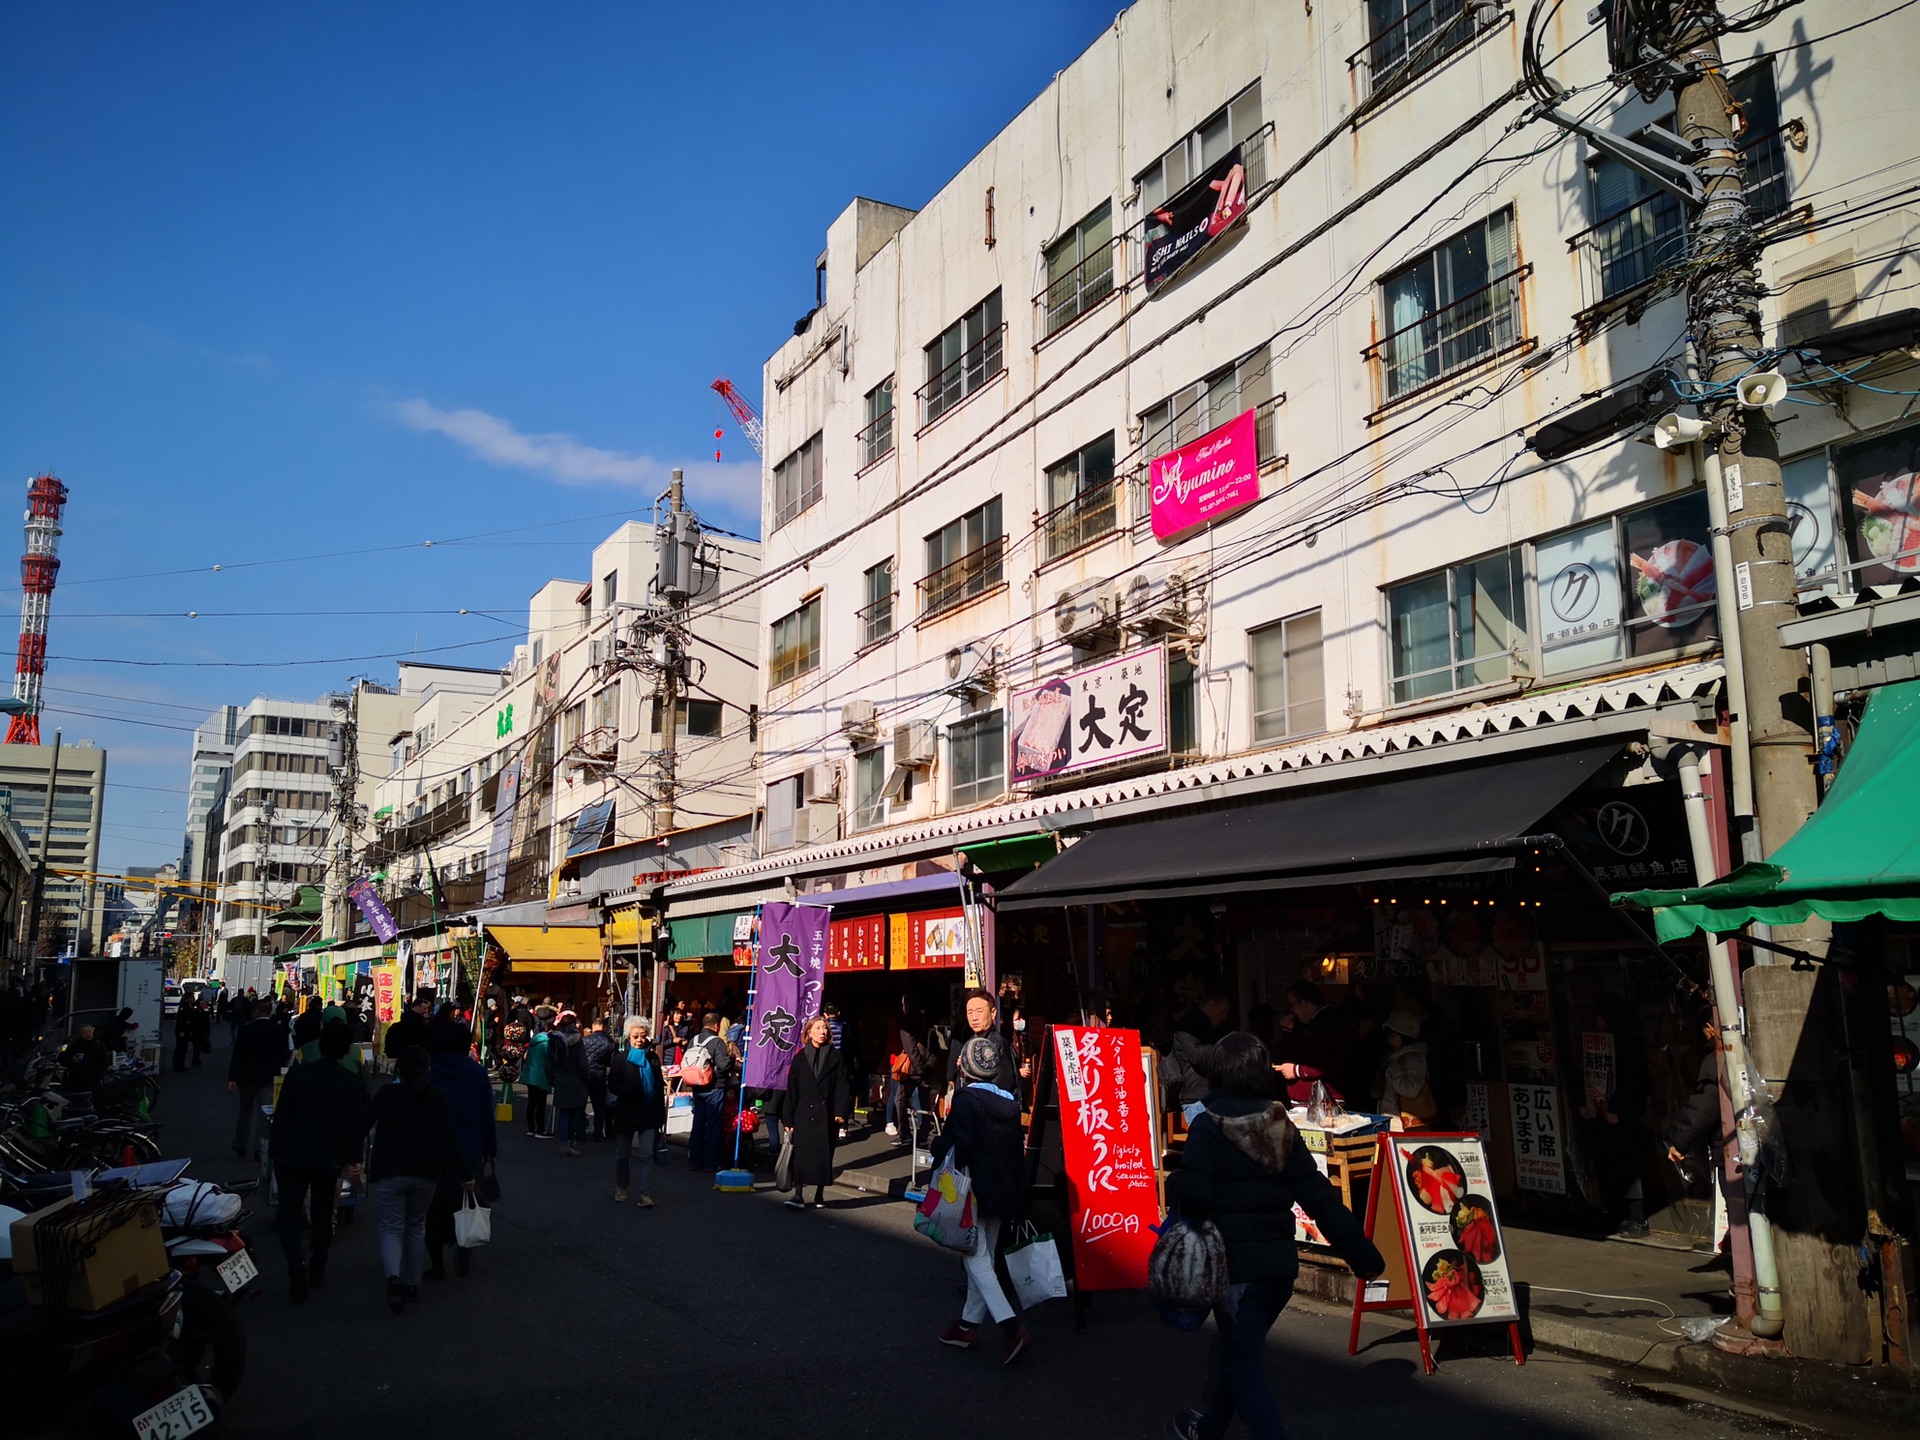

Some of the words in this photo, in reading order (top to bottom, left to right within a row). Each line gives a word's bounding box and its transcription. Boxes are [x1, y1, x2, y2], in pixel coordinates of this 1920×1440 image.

[1175, 226, 1199, 250] NAILS
[1153, 452, 1236, 504] Ayumino
[1741, 576, 1750, 600] 235
[1078, 682, 1153, 754] 大定
[1593, 858, 1689, 881] 黒瀬鮮魚店
[809, 930, 824, 970] 玉子焼
[756, 932, 807, 1052] 大定
[1075, 1031, 1119, 1193] 炙り板うに
[1513, 1087, 1534, 1154] あります
[1533, 1088, 1556, 1157] 広い席
[1517, 1156, 1539, 1168] Larger
[1540, 1159, 1561, 1169] room
[1520, 1165, 1527, 1174] is
[1528, 1166, 1559, 1177] available
